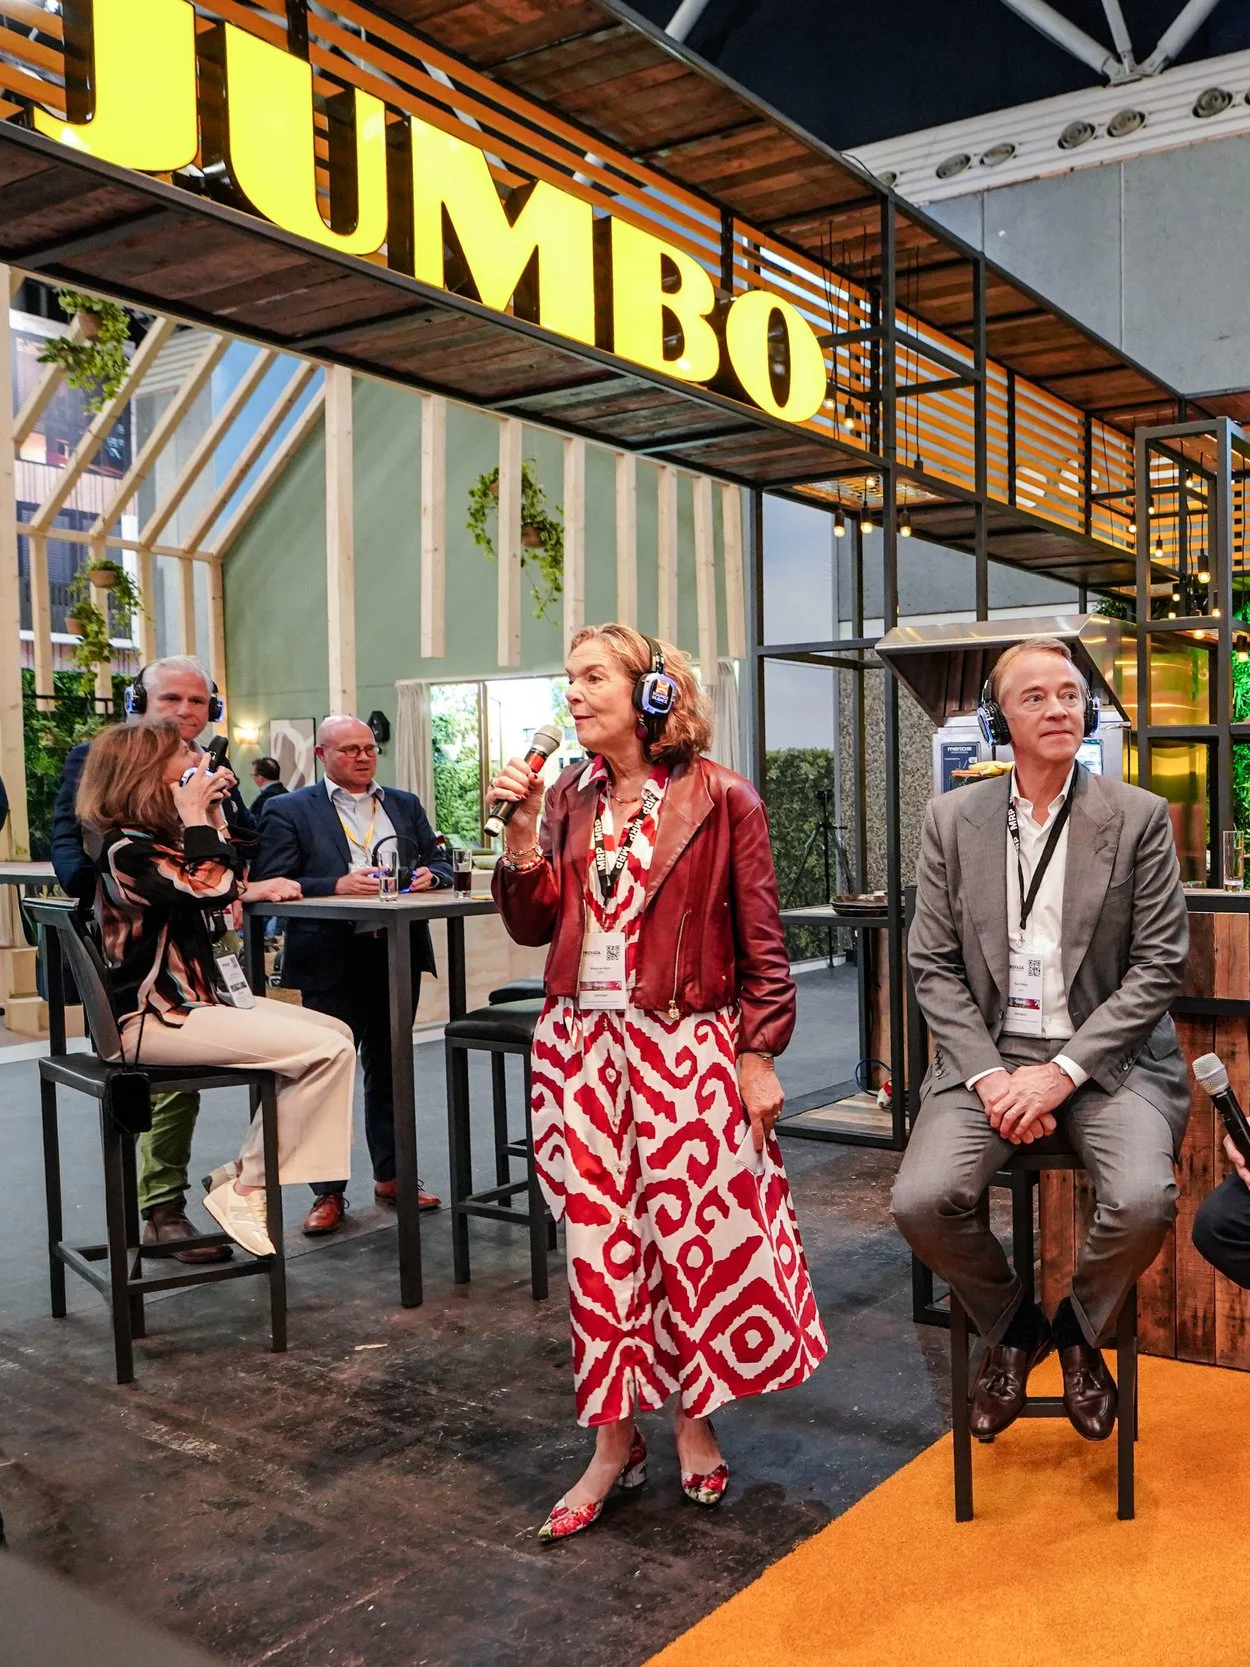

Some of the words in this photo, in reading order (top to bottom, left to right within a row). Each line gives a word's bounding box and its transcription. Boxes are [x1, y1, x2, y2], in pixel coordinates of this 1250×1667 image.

[33, 0, 826, 423] JUMBO
[643, 796, 656, 814] MRP
[594, 819, 604, 841] MRP
[629, 818, 643, 842] MRP
[1008, 808, 1018, 830] MRP
[595, 847, 606, 871] MRP
[615, 846, 630, 869] MRP
